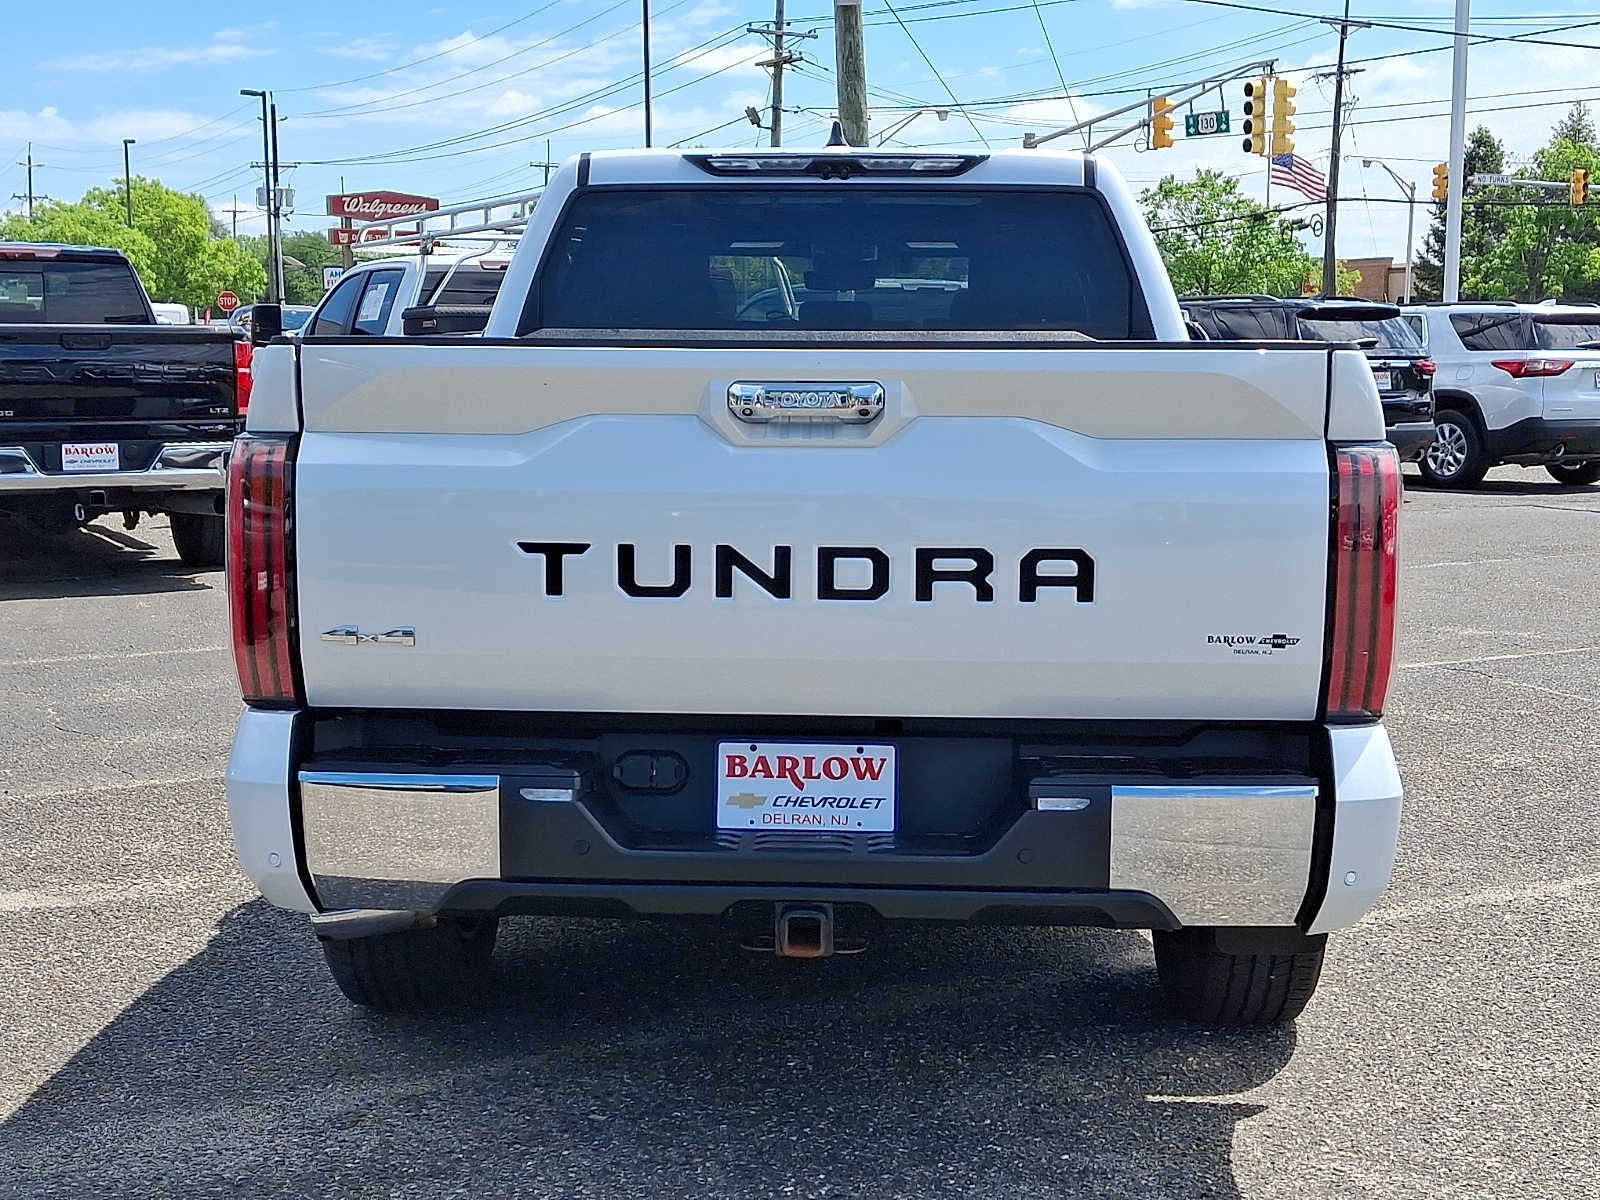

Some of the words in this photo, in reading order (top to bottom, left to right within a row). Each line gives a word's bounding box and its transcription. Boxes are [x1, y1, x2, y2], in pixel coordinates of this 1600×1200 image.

[1201, 117, 1215, 130] 130
[1477, 176, 1487, 184] NO
[1489, 176, 1509, 184] TURNS
[342, 196, 427, 218] Walgreens
[220, 297, 236, 306] STOP
[769, 391, 842, 409] TOYOTA
[64, 446, 116, 458] BARLOW
[515, 540, 1097, 603] TUNDRA
[1207, 635, 1257, 647] BARLOW
[725, 755, 887, 791] BARLOW
[772, 795, 887, 810] CHEVROLET
[762, 813, 826, 826] DELRAN,
[831, 815, 849, 826] NJ
